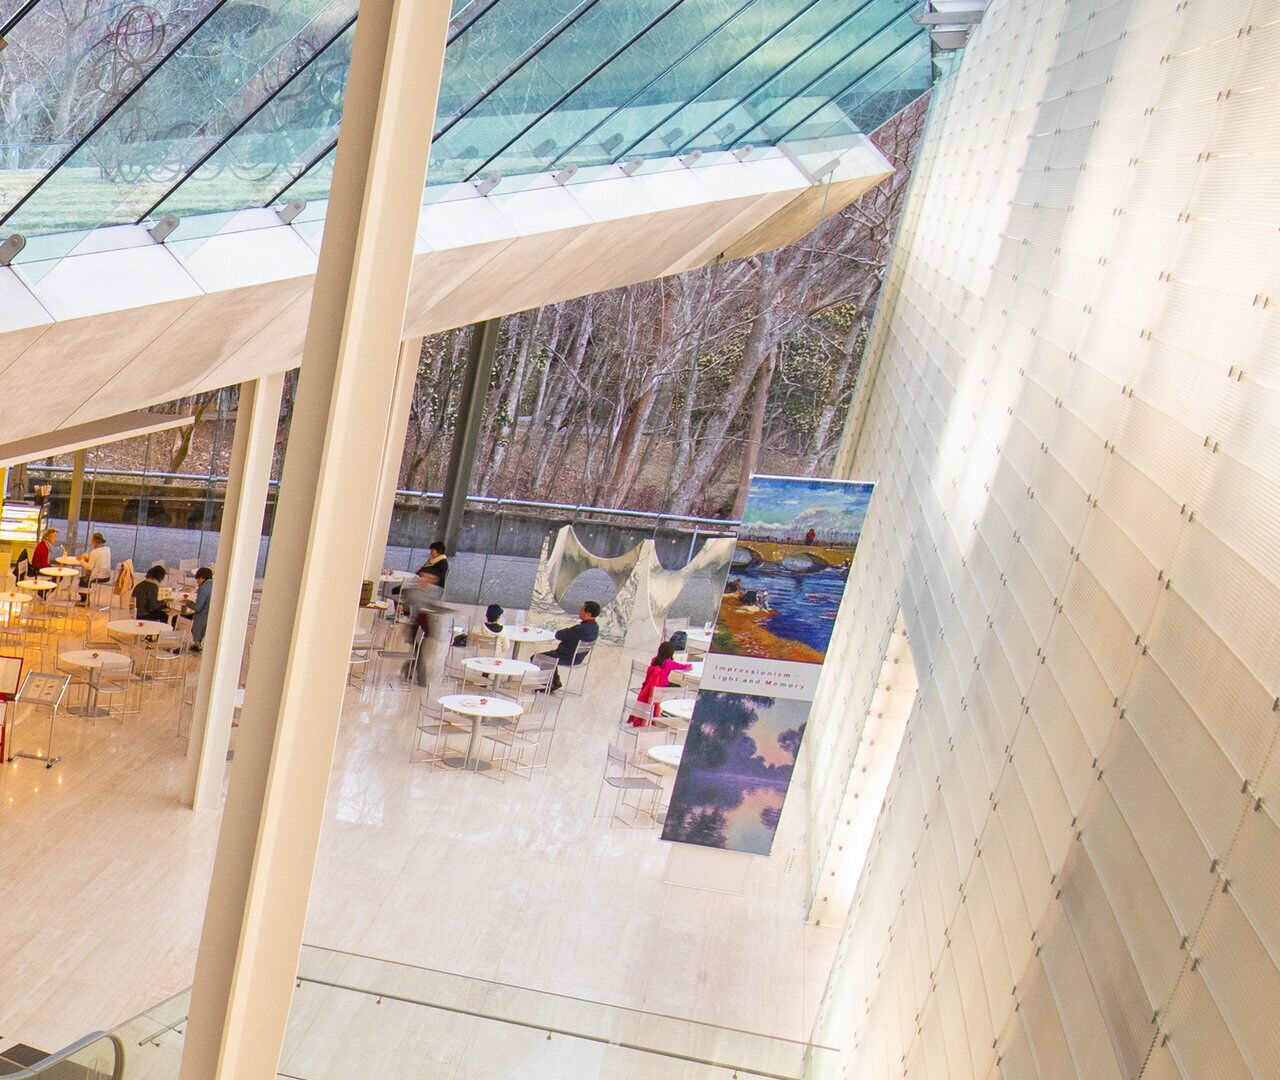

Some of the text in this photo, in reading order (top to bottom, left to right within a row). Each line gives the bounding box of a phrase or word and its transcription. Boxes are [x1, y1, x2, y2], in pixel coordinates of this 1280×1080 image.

[715, 665, 791, 678] Impressionism
[712, 674, 738, 682] Light
[765, 680, 805, 690] Memory
